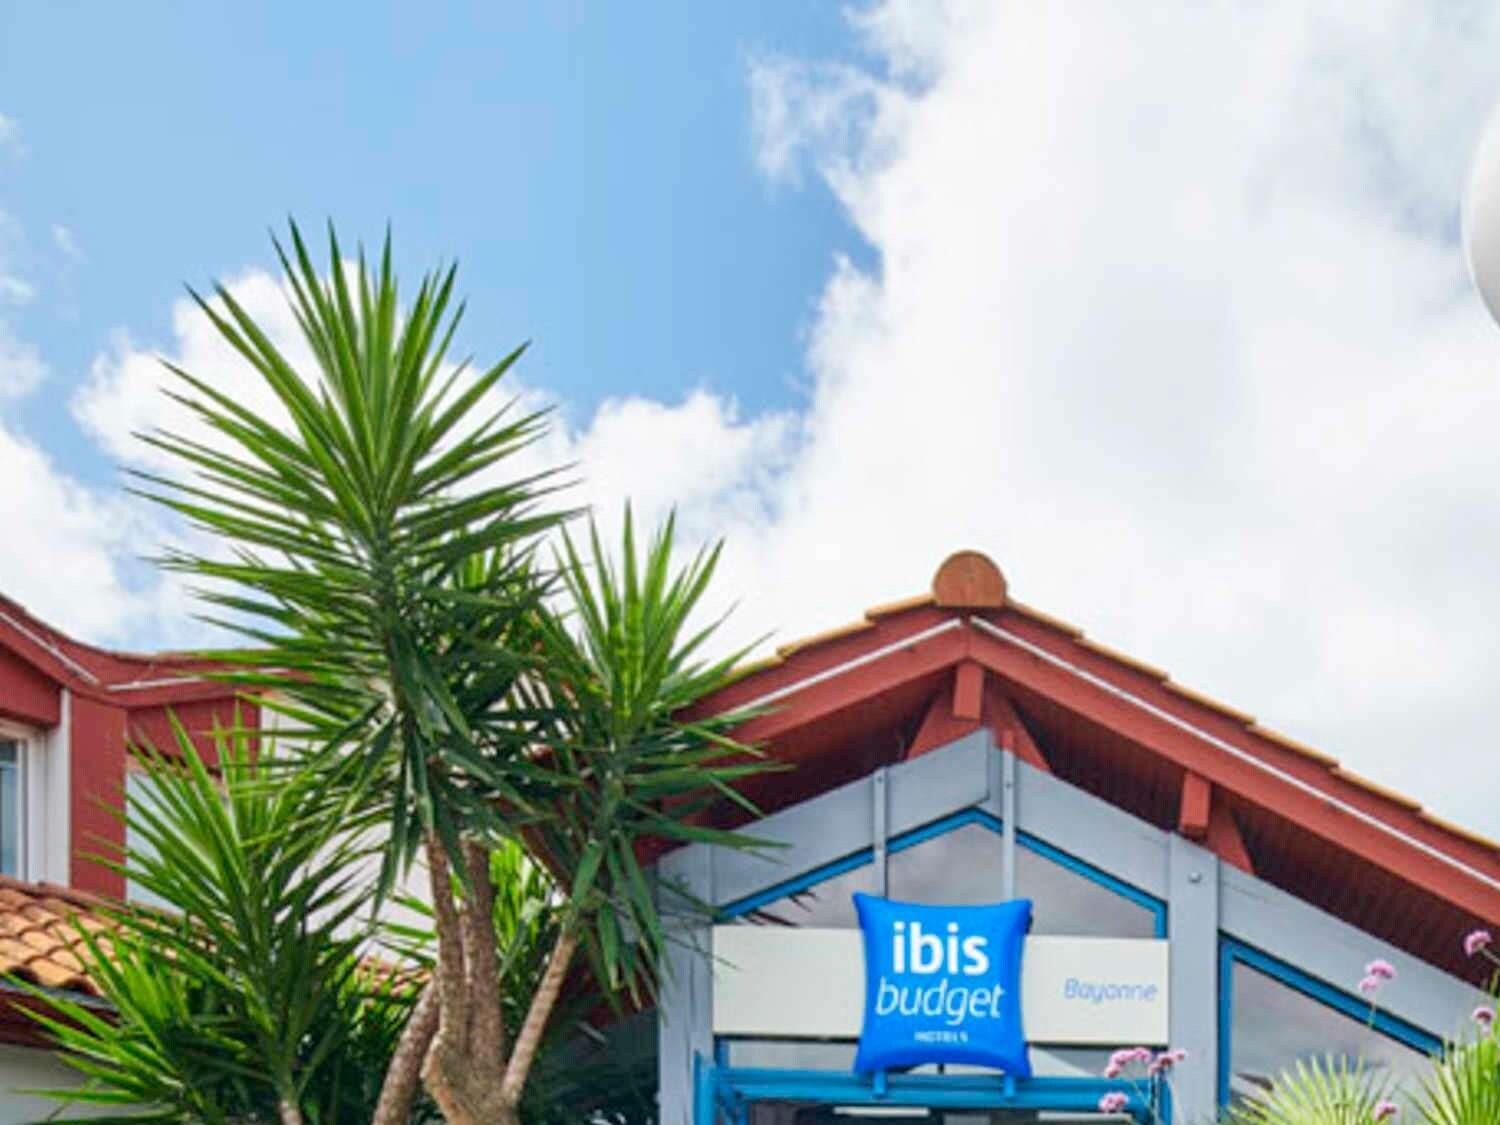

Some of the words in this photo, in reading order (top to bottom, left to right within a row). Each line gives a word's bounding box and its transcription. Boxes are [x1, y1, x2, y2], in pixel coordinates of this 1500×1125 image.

[893, 921, 990, 976] ibis
[875, 976, 1006, 1026] budget
[1064, 976, 1158, 1005] Bayonne
